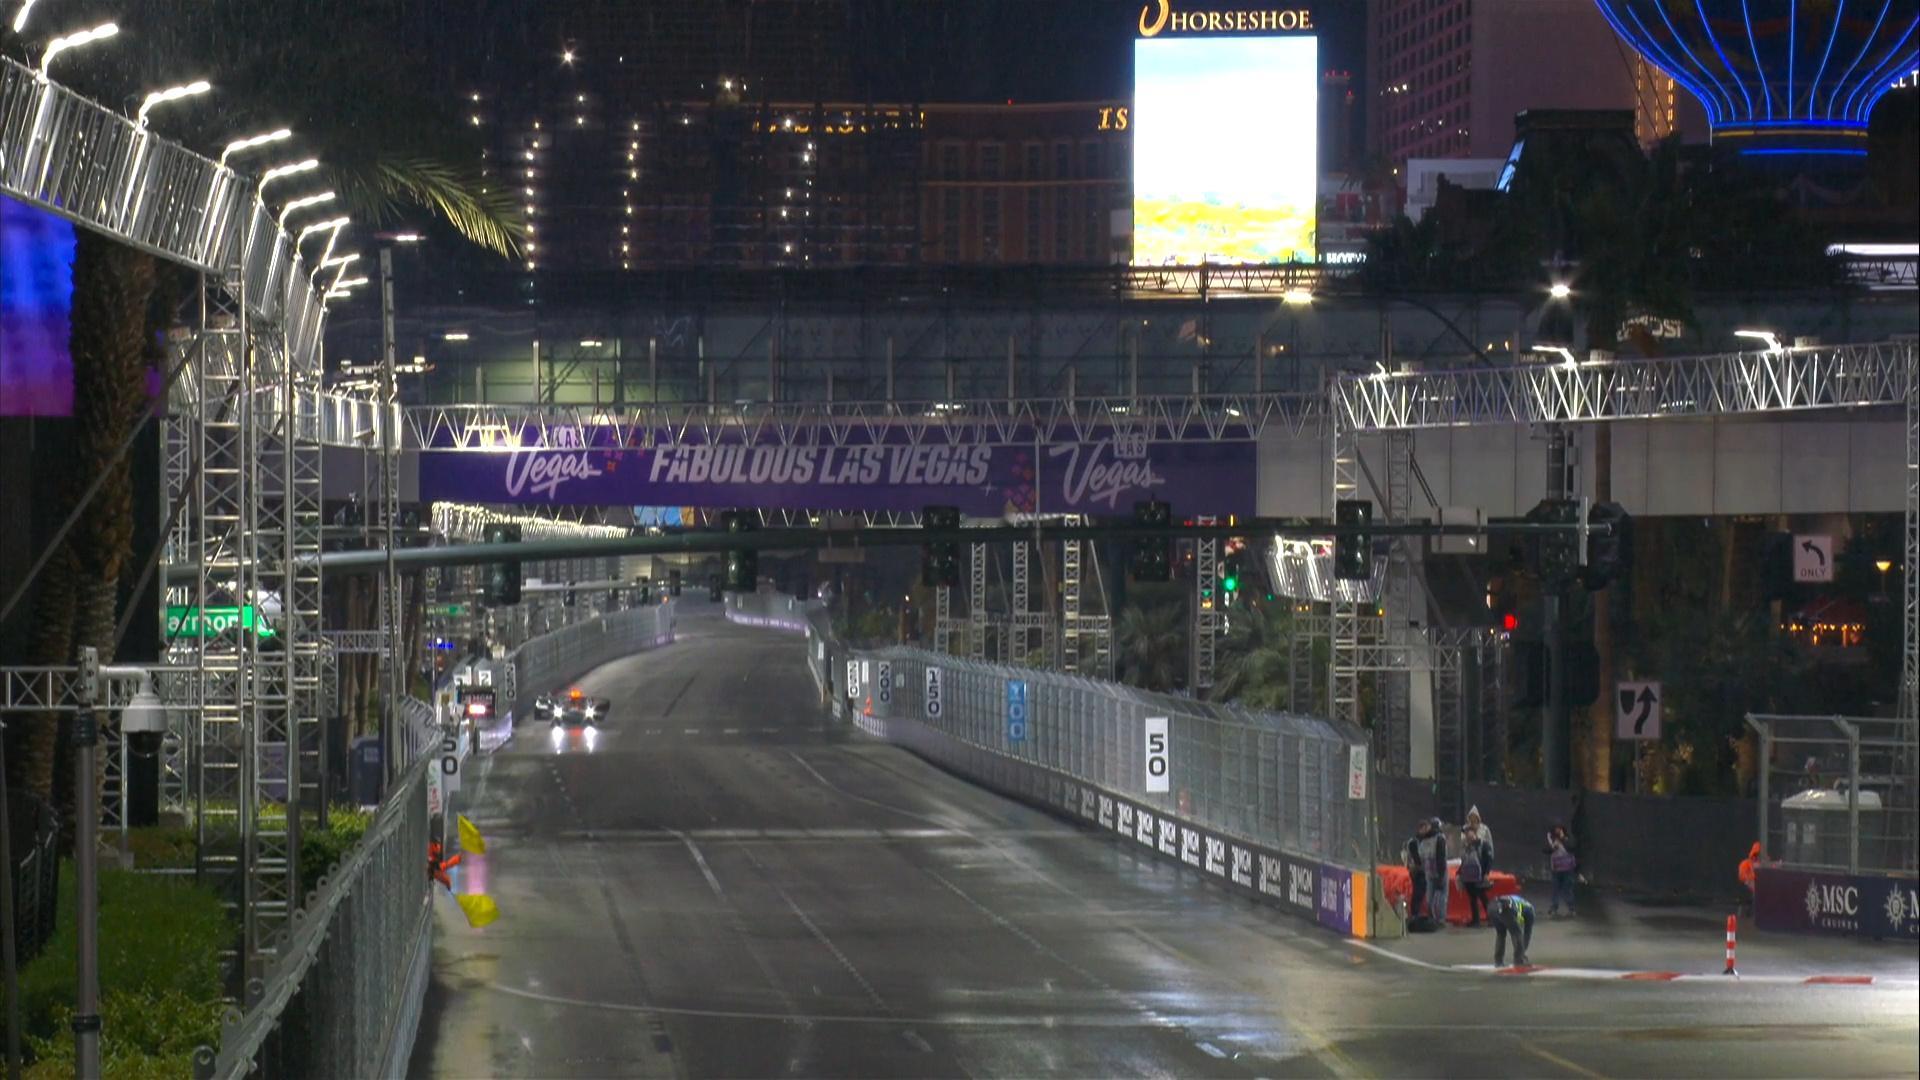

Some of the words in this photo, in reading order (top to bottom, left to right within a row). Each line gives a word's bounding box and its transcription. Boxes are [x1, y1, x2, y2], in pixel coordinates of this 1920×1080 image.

[497, 434, 602, 499] Vegas
[650, 444, 818, 484] FABULOUS
[819, 444, 883, 485] LAS
[889, 444, 992, 485] VEGAS
[1113, 433, 1148, 458] LAS
[1049, 437, 1165, 509] Vegas
[1801, 567, 1826, 577] ONLY
[880, 664, 890, 702] 200
[928, 669, 940, 715] 150
[1009, 683, 1025, 739] 100
[1149, 733, 1166, 776] 50
[1821, 885, 1859, 916] MSC
